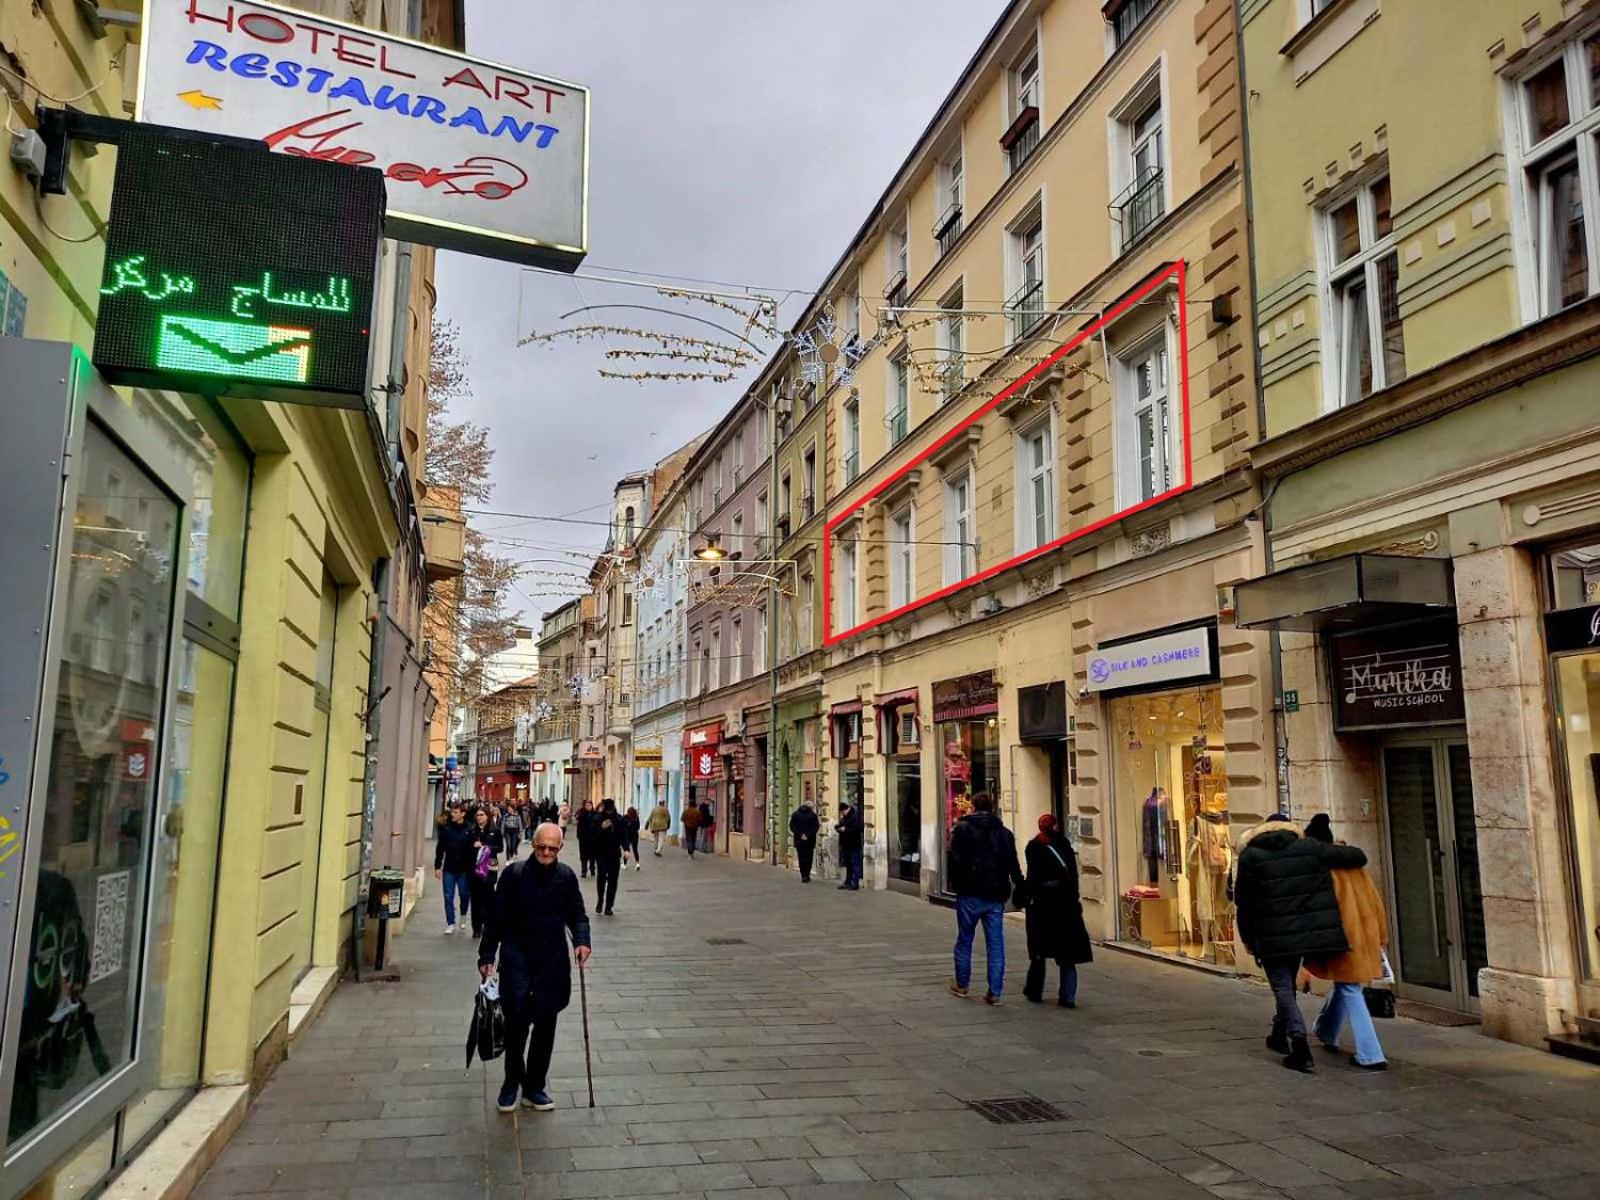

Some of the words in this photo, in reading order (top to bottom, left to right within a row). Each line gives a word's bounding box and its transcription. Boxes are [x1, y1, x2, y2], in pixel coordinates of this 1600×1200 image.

[185, 0, 416, 79] HOTEL
[442, 67, 566, 114] ART
[185, 39, 560, 149] RESTAURANT
[1111, 661, 1128, 673] SILK
[1131, 657, 1148, 668] AND
[1152, 647, 1200, 665] CASHMERE
[1374, 696, 1404, 708] MUSIC
[1405, 693, 1445, 706] SCHOOL
